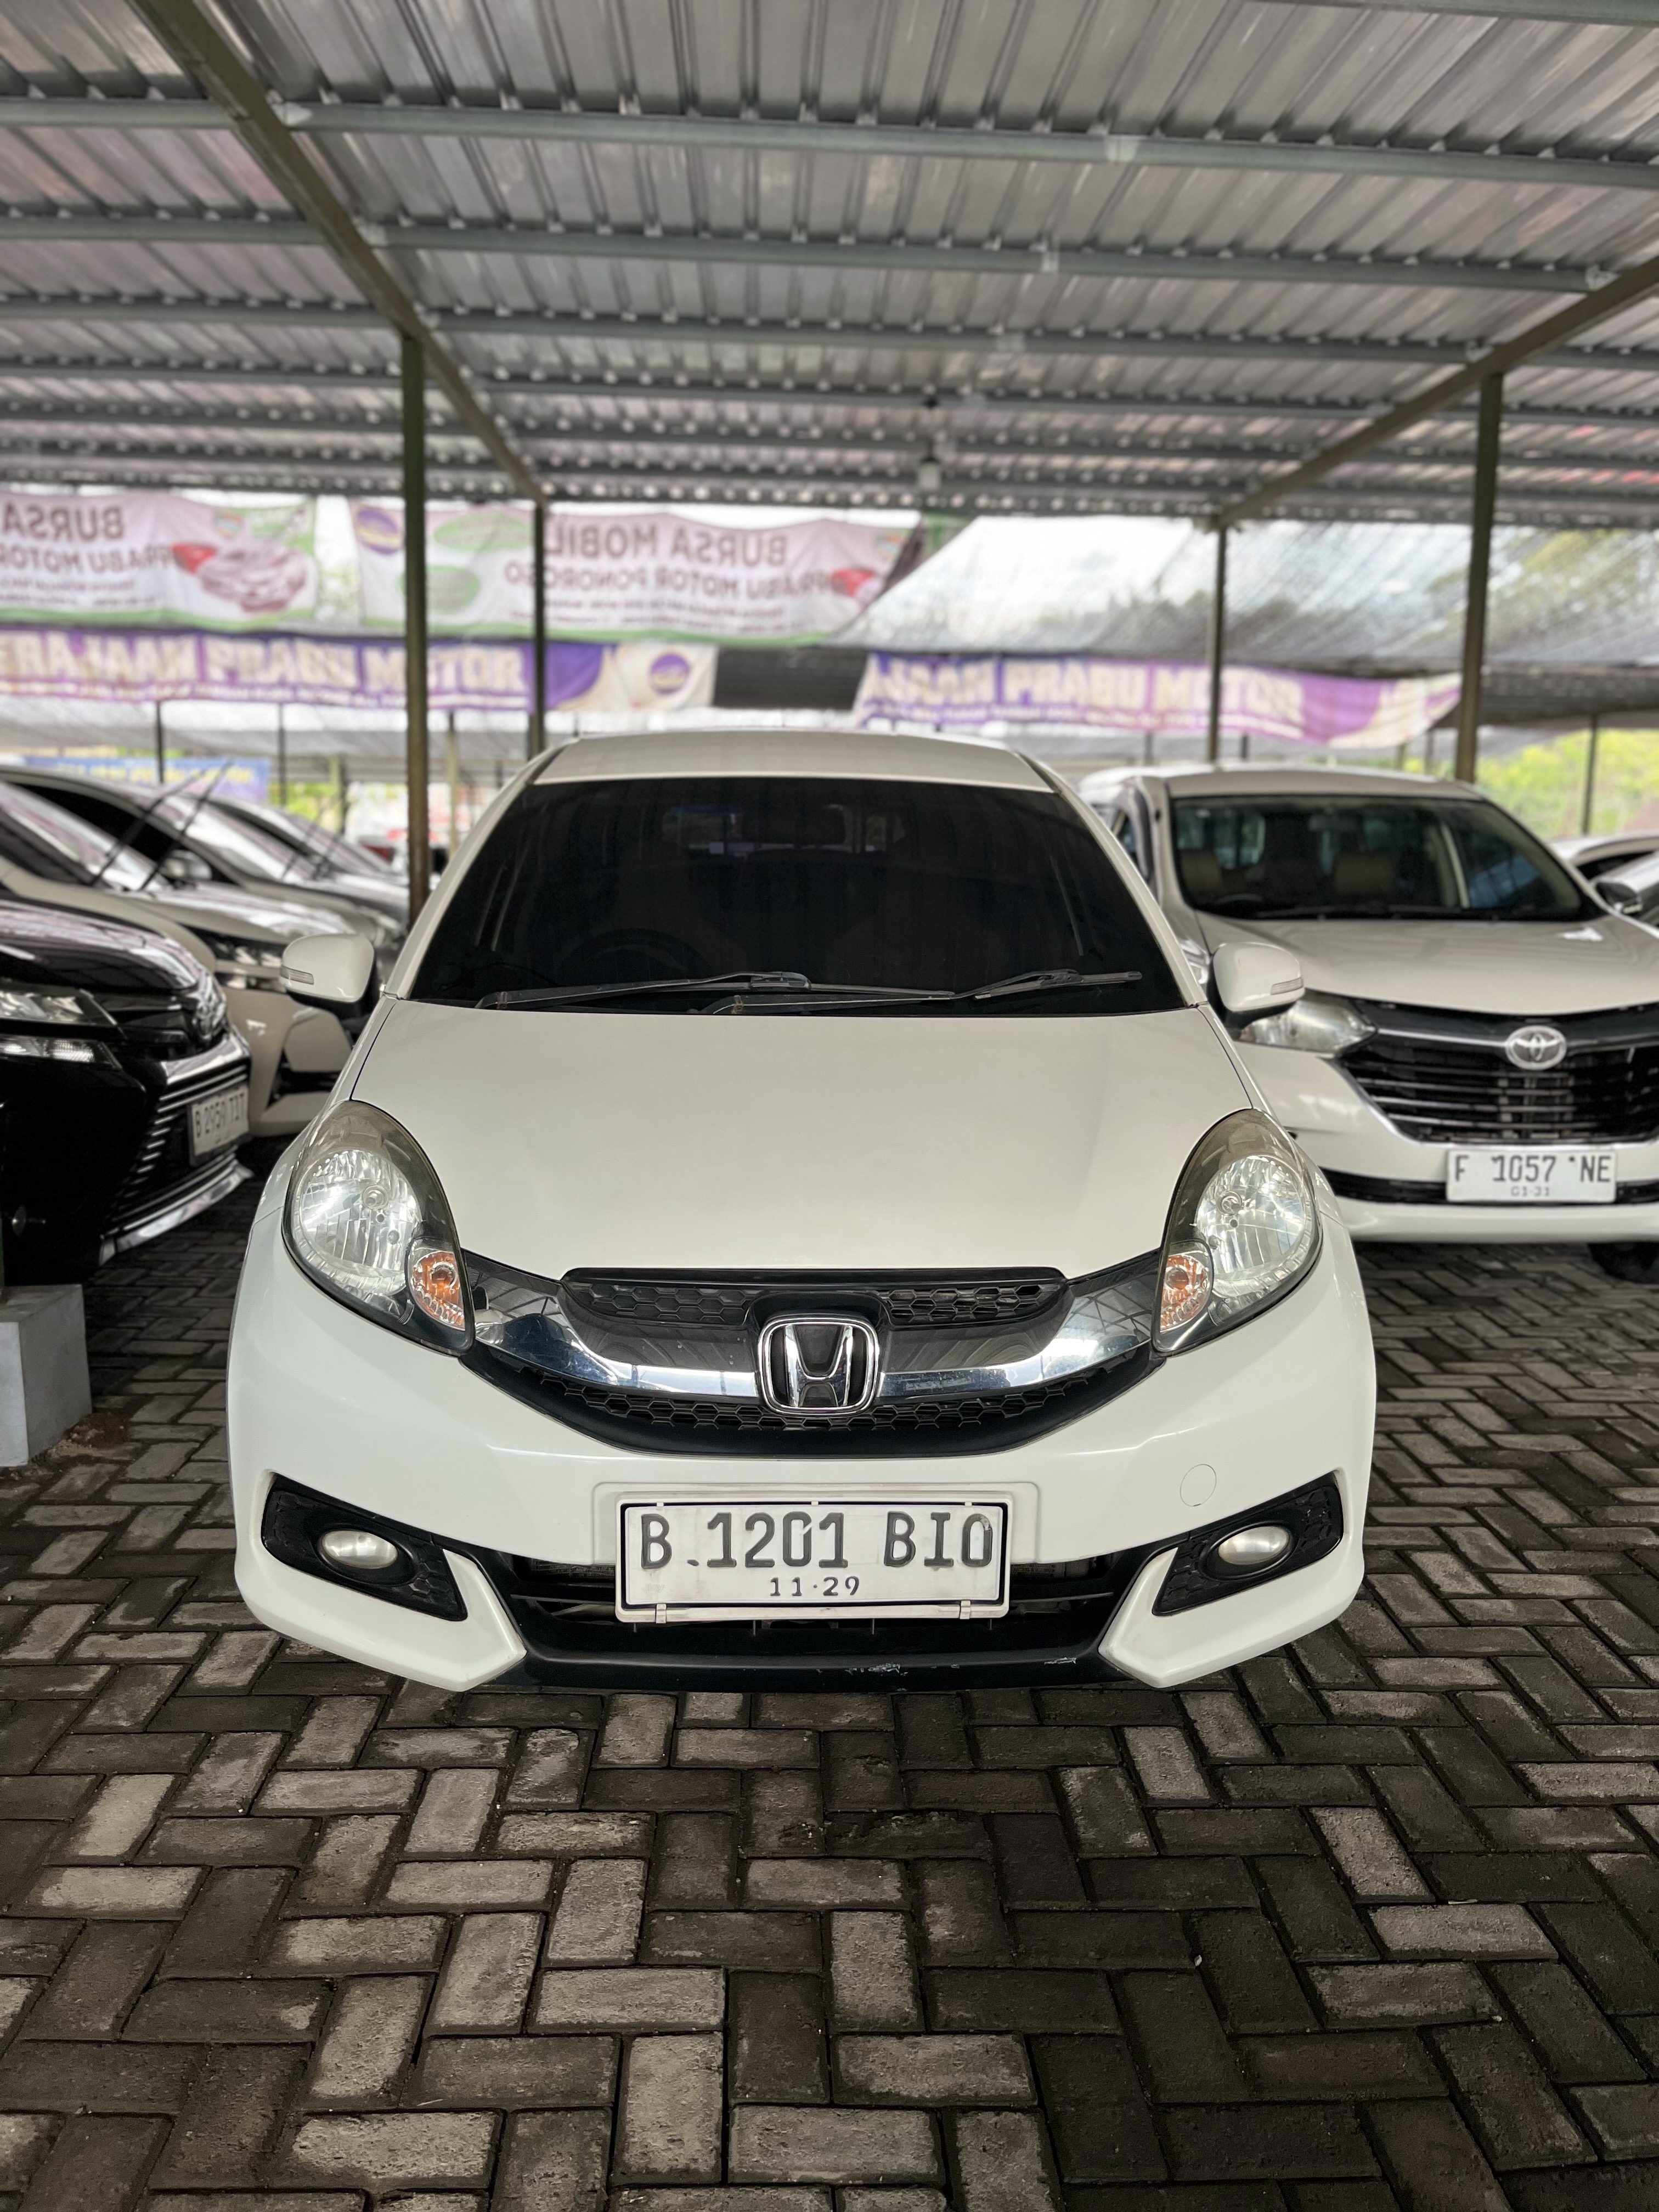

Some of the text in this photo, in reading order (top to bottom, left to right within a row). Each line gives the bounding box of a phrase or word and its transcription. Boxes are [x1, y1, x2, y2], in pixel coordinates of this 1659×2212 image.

[1455, 1155, 1611, 1183] F 1057 NE
[640, 1511, 993, 1568] B 1201 BIO
